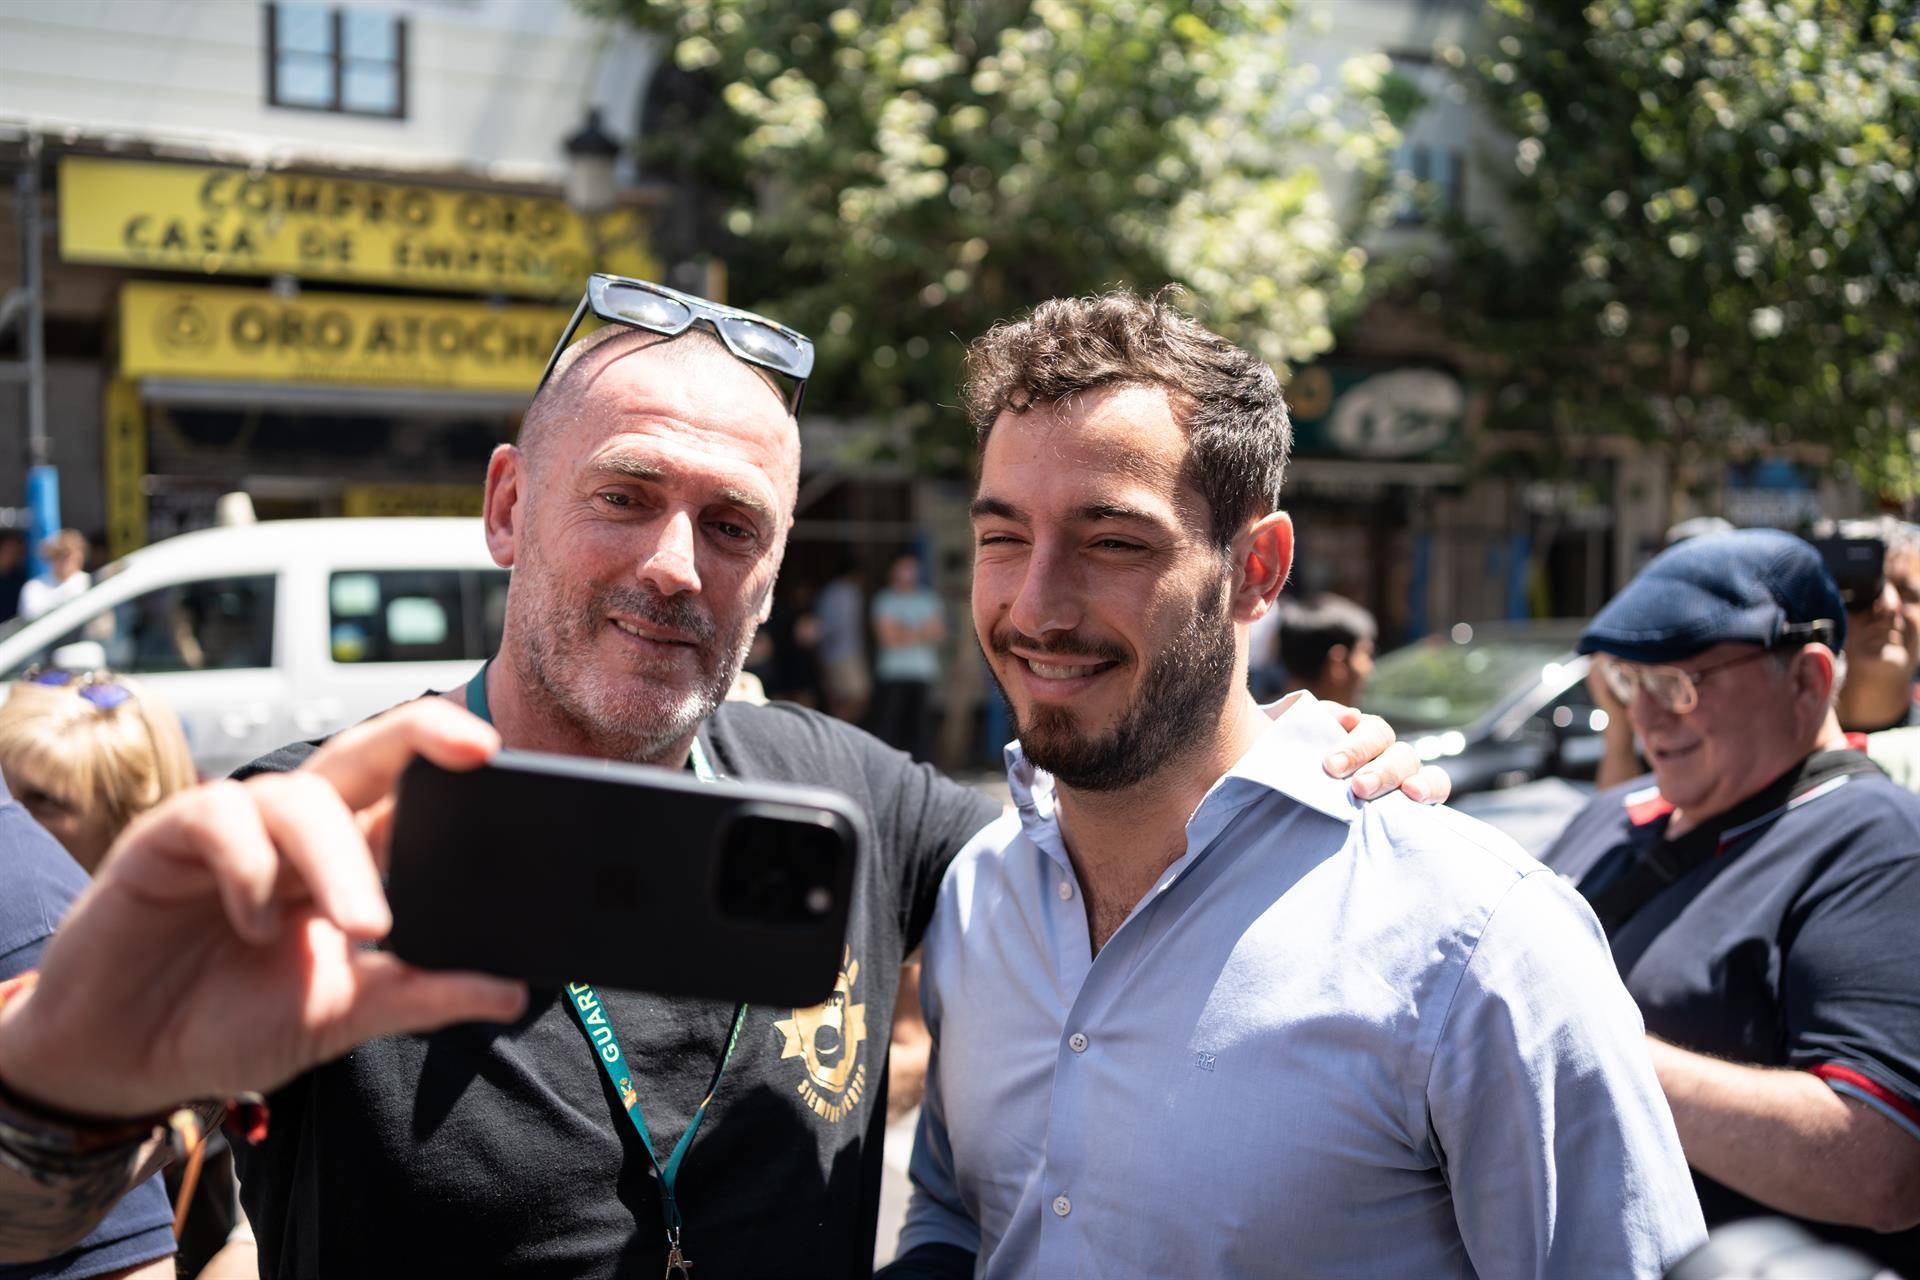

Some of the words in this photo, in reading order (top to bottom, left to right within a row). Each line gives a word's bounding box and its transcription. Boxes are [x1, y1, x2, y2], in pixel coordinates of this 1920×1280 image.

[200, 169, 434, 229] COMPRO
[454, 190, 567, 240] ORO
[122, 213, 258, 255] CASA
[300, 226, 358, 264] DE
[229, 304, 356, 357] ORO
